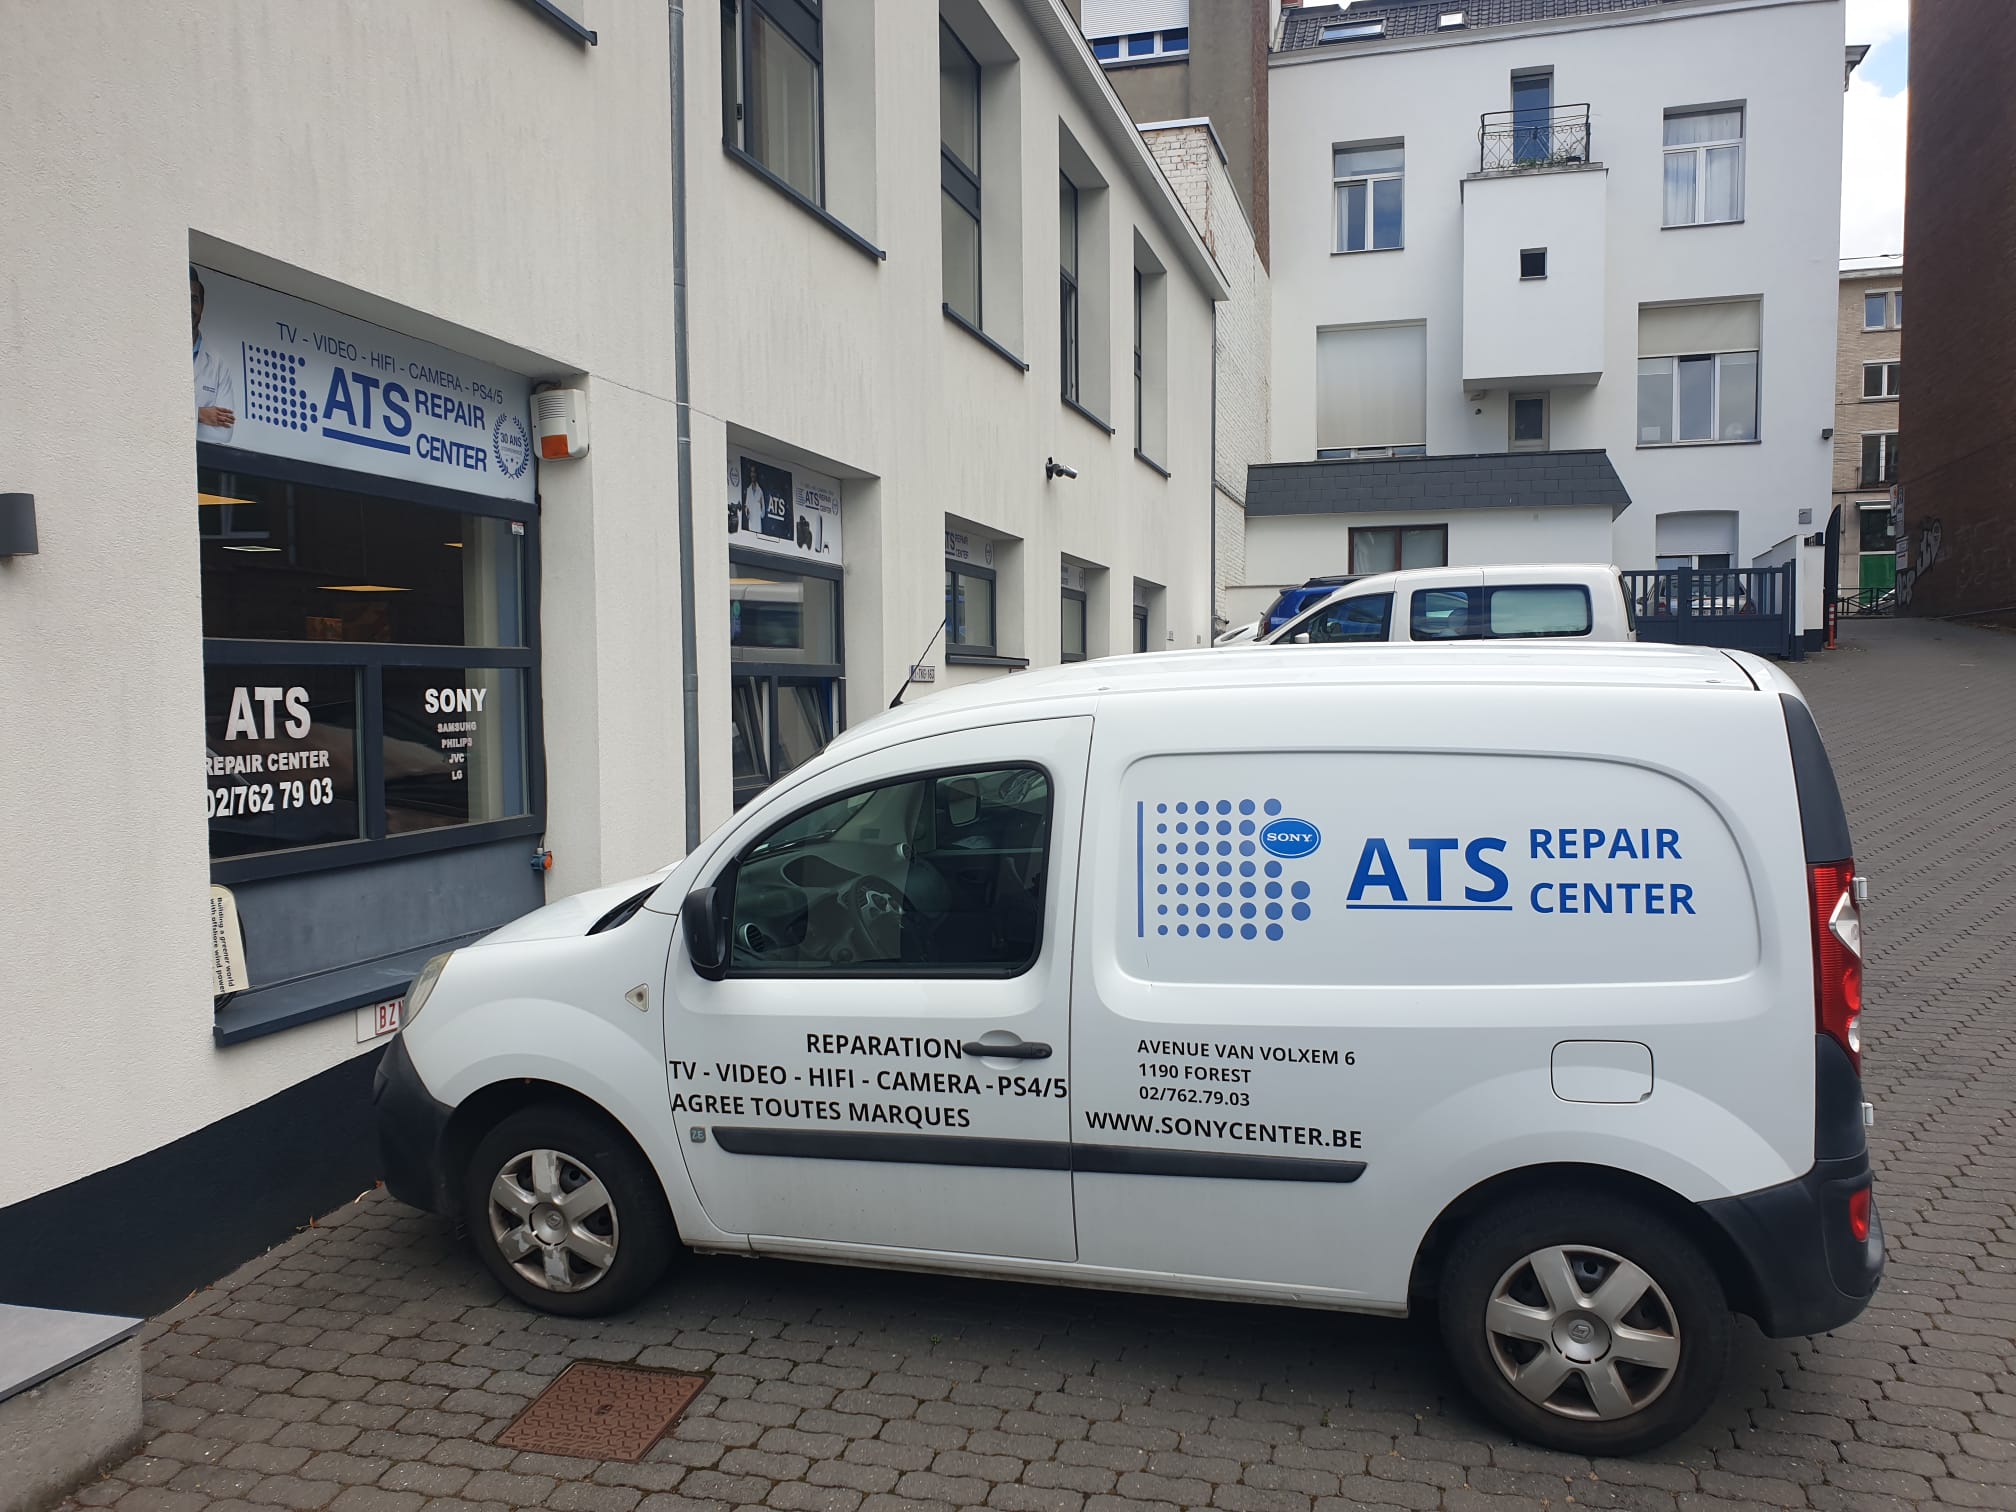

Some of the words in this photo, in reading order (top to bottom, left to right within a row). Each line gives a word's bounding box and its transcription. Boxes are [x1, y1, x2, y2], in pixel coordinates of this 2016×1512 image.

[276, 322, 298, 344] TV
[312, 332, 357, 361] VIDEO
[370, 348, 396, 373] HIFI
[408, 363, 462, 393] CAMERA
[472, 381, 503, 405] PS4/5
[322, 366, 413, 437] ATS
[415, 389, 486, 430] REPAIR
[416, 433, 487, 473] CENTER
[500, 432, 508, 444] 30
[510, 434, 522, 448] ANS
[767, 495, 786, 516] ATS
[805, 490, 820, 507] ATS
[945, 530, 955, 550] TS
[224, 686, 312, 741] ATS
[424, 688, 488, 714] SONY
[437, 721, 477, 733] SAMSUNG
[441, 737, 473, 749] PHILIPS
[206, 754, 264, 776] REPAIR
[267, 750, 330, 771] CENTER
[448, 753, 465, 764] JVC
[451, 769, 463, 781] LG
[279, 780, 304, 809] 79
[310, 777, 334, 806] 03
[1266, 832, 1312, 842] SONY
[1530, 828, 1683, 860] REPAIR
[1346, 837, 1509, 903] ATS
[1530, 882, 1697, 915] CENTER
[211, 916, 219, 948] offshore
[214, 949, 222, 969] wind
[219, 936, 229, 963] greener
[226, 964, 235, 987] world
[215, 970, 225, 993] power
[806, 1033, 962, 1059] REPARATION
[1137, 1039, 1210, 1058] AVENUE
[1214, 1043, 1254, 1060] VAN
[1259, 1046, 1339, 1065] VOLXEM
[1344, 1051, 1356, 1066] 6
[669, 1060, 697, 1080] TV
[715, 1062, 787, 1085] VIDEO
[808, 1067, 854, 1089] HIFI
[876, 1070, 981, 1095] CAMERA
[998, 1076, 1068, 1099] PS4/5
[1139, 1063, 1179, 1079] 1190
[1184, 1065, 1251, 1083] FOREST
[1139, 1086, 1250, 1107] 02/762.79.03
[671, 1093, 745, 1115] AGREE
[751, 1097, 841, 1121] TOUTES
[848, 1102, 970, 1129] MARQUES
[1085, 1111, 1362, 1149] WWW.SONYCENTER.BE
